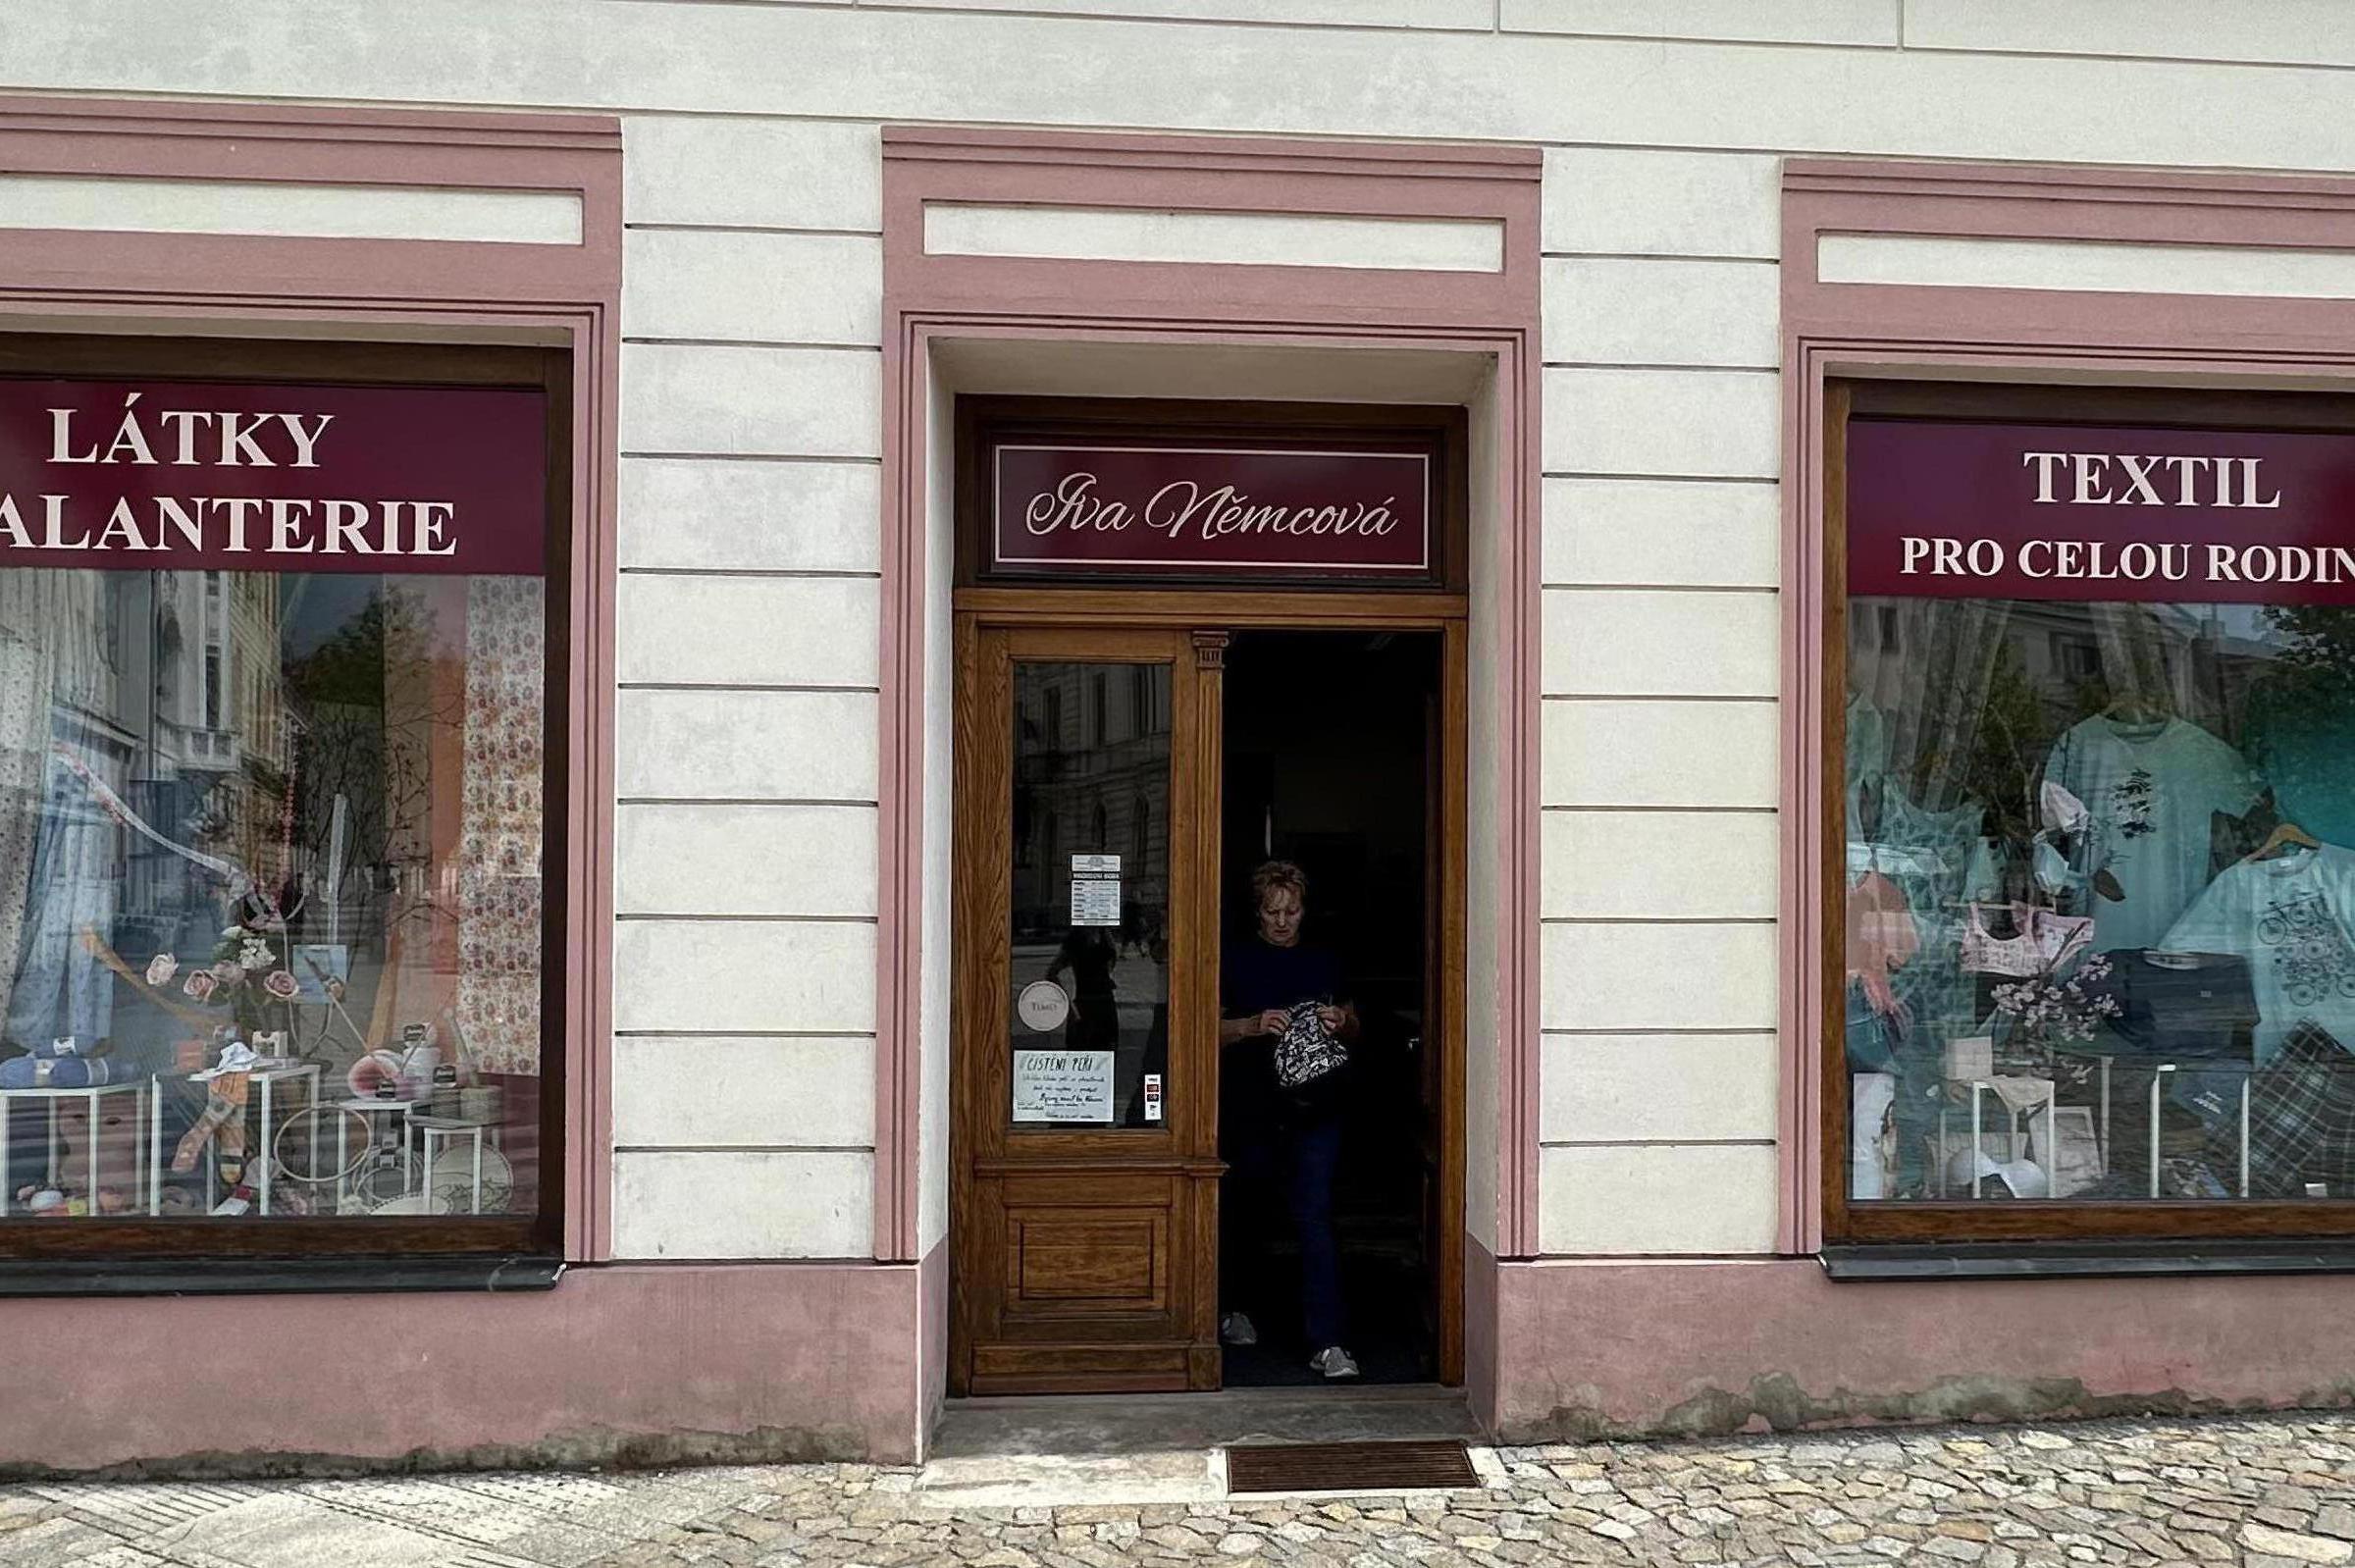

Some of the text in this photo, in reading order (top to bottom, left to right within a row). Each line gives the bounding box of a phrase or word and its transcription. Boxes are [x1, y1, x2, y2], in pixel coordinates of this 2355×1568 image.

[46, 392, 336, 468] LÁTKY
[1025, 472, 1398, 541] Iva Němcová
[2023, 452, 2281, 508] TEXTIL
[1900, 537, 2005, 577] PRO
[2017, 540, 2193, 581] CELOU
